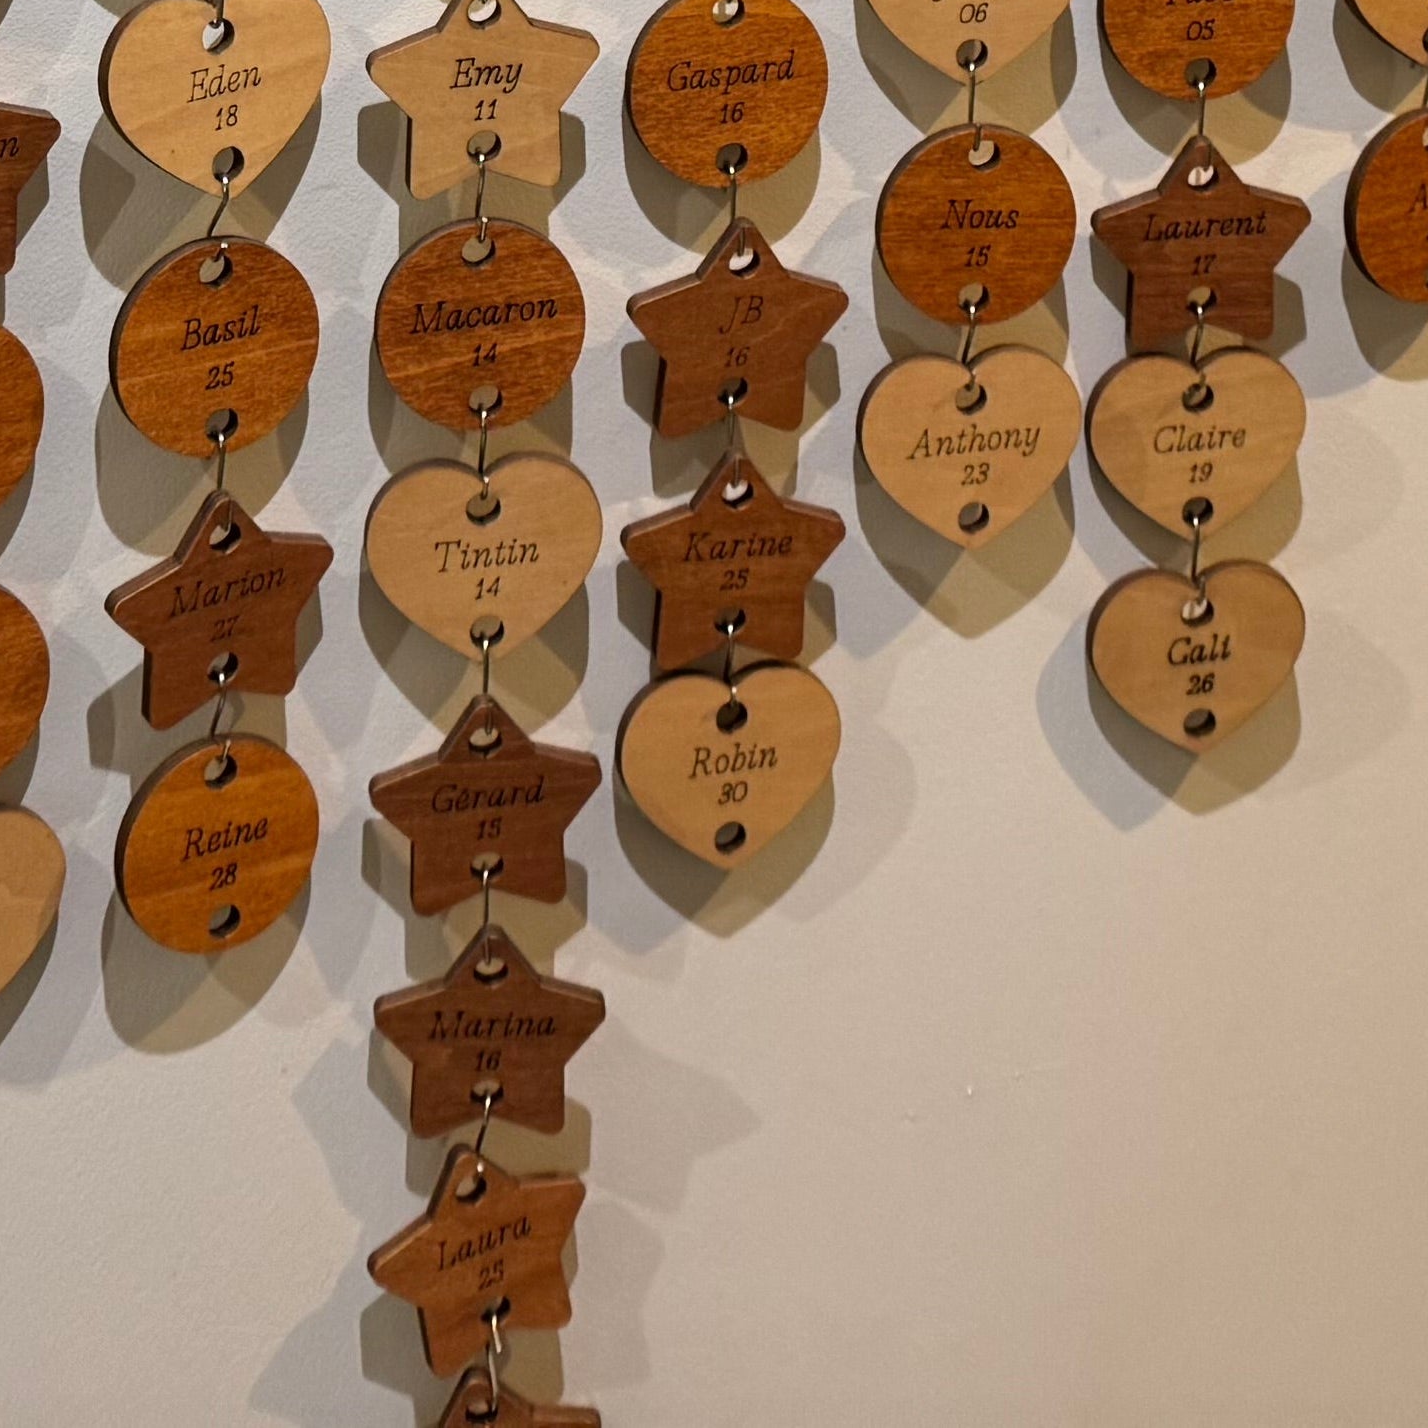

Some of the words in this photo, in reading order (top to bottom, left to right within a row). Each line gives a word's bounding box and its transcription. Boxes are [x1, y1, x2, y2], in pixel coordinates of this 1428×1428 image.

[959, 3, 989, 25] 06
[1186, 19, 1216, 42] 05
[186, 65, 262, 103] Eden
[450, 56, 523, 94] Emy
[666, 53, 796, 95] Gaspard
[214, 104, 239, 131] 18
[473, 99, 498, 122] 11
[720, 101, 744, 124] 16
[941, 199, 1020, 232] Nous
[1142, 210, 1267, 243] Laurent
[966, 245, 991, 269] 15
[1191, 253, 1216, 276] 17
[410, 294, 558, 335] Macaron
[720, 295, 765, 329] JB
[180, 306, 261, 353] Basil
[470, 343, 498, 369] 14
[723, 344, 749, 368] 16
[204, 362, 235, 391] 25
[906, 422, 1041, 461] Anthony
[1153, 423, 1247, 453] Claire
[960, 462, 990, 486] 23
[1188, 462, 1213, 485] 19
[435, 537, 540, 573] Tintin
[682, 529, 794, 563] Karine
[170, 563, 287, 619] Marion
[474, 576, 502, 601] 14
[720, 567, 750, 592] 25
[208, 612, 239, 644] 27
[1186, 672, 1214, 695] 26
[690, 740, 779, 780] Robin
[716, 780, 749, 806] 30
[181, 814, 270, 862] Reine
[475, 816, 502, 841] 15
[208, 863, 239, 892] 28
[428, 1010, 557, 1043] Marina
[473, 1050, 501, 1074] 16
[438, 1216, 532, 1271] Laura
[478, 1259, 504, 1290] 25
